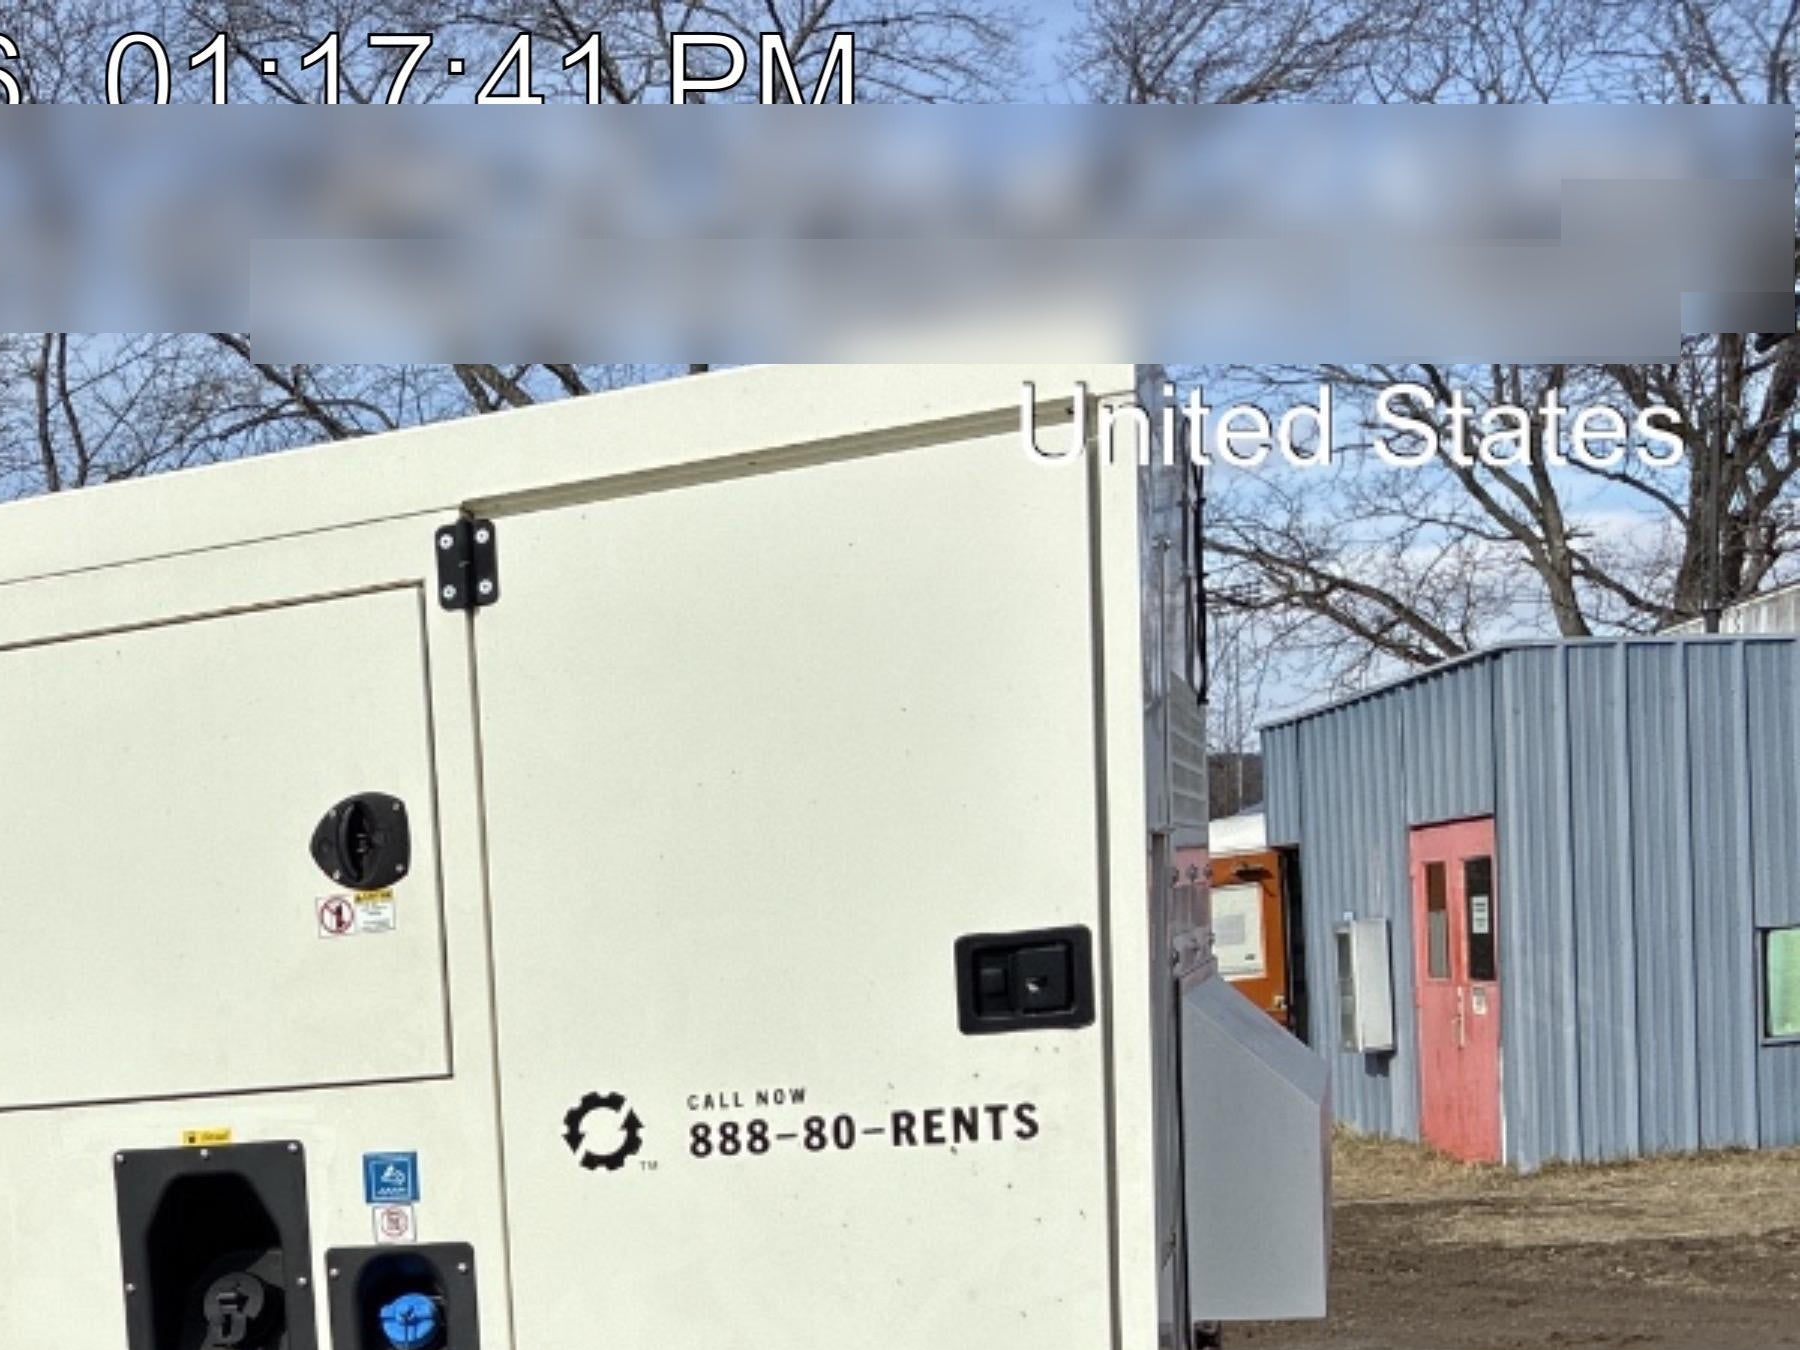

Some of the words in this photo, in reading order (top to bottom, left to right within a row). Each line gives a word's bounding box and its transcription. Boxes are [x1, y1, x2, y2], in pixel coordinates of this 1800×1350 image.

[686, 1091, 745, 1111] CALL
[755, 1087, 807, 1107] NOW
[689, 1101, 1041, 1158] 888-80-RENTS
